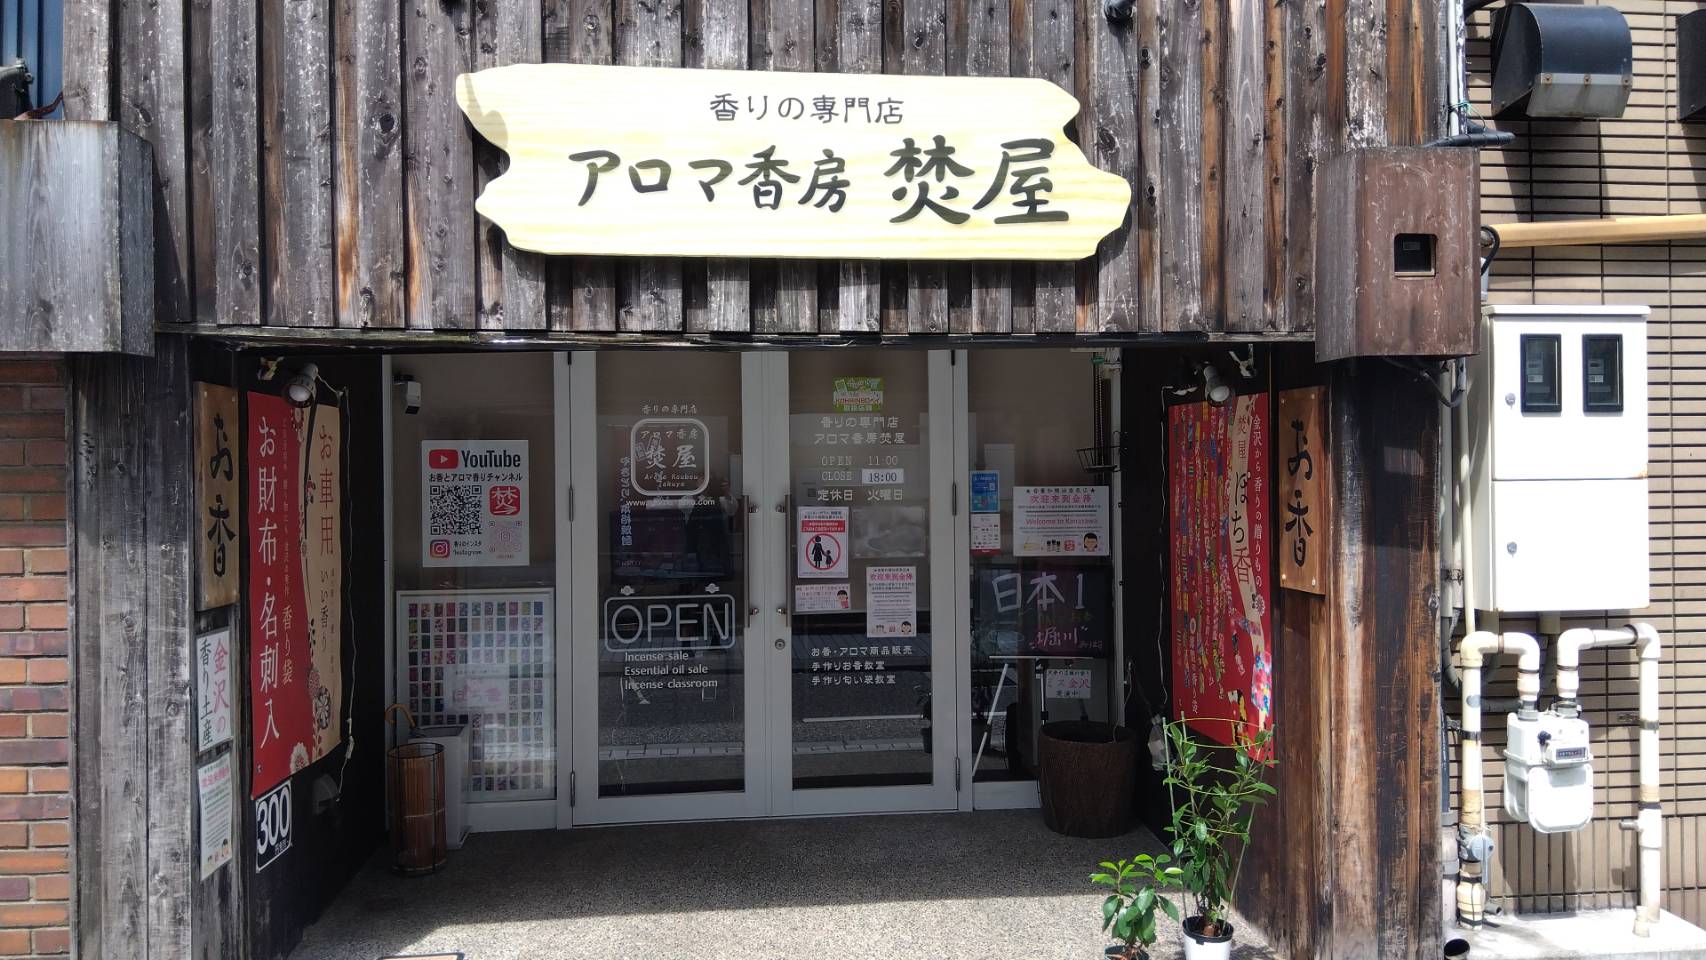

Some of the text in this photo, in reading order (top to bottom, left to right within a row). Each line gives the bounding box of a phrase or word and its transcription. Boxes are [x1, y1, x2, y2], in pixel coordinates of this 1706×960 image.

[709, 93, 904, 125] 香りの専門店
[568, 135, 1071, 226] アロマ香房 焚屋
[641, 404, 698, 415] 香りの専門店
[820, 416, 899, 429] 香りの専門店
[814, 432, 906, 445] アロマ香房焚屋
[461, 450, 521, 468] YouTube
[645, 443, 697, 470] 焚屋
[821, 455, 898, 466] OPEN 11:00
[428, 473, 522, 483] お香とアロマ香りチャンネル
[821, 471, 897, 482] CLOSE 18:00
[207, 414, 237, 577] お香
[319, 425, 334, 556] お車用
[817, 489, 903, 501] 定休日 火曜日
[1285, 419, 1313, 568] お香
[1252, 416, 1263, 588] 金沢から香りの贈りもの
[1025, 518, 1056, 526] Welcome
[257, 417, 280, 749] お財布・名刺入
[611, 602, 730, 644] OPEN
[624, 651, 689, 662] Incense sale
[811, 646, 913, 656] お香・アロマ商品販売
[624, 664, 709, 676] Essential oil sale
[811, 661, 885, 670] 手作りお香教室
[213, 640, 229, 732] 金沢の
[624, 679, 718, 690] Incense classroom
[200, 639, 213, 746] 香り土産
[256, 786, 289, 855] 300
